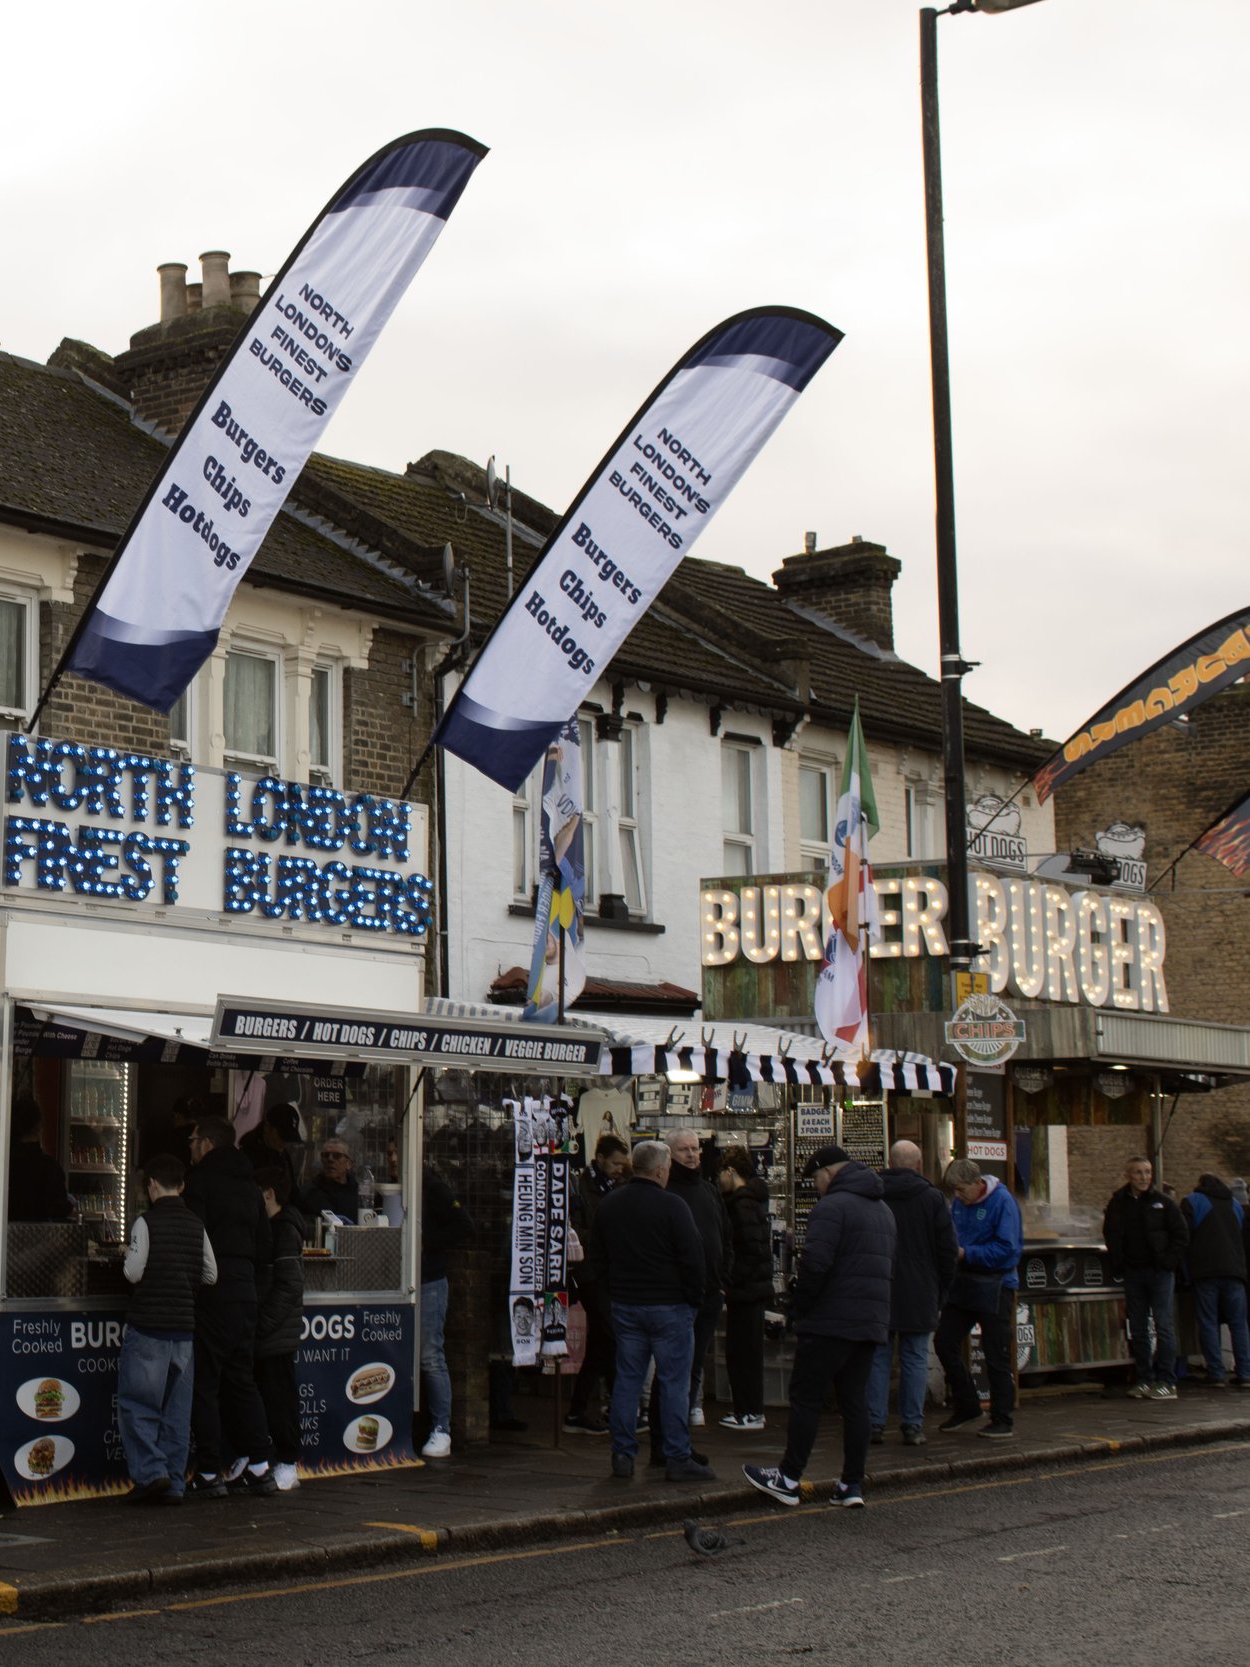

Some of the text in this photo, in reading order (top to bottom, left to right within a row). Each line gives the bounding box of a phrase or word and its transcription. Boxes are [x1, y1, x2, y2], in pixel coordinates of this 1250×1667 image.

[274, 294, 352, 372] LONDON'S
[298, 283, 354, 340] NORTH
[248, 338, 328, 416] BURGERS
[270, 325, 328, 384] FINEST
[210, 400, 287, 485] Burgers
[656, 427, 712, 486] NORTH
[202, 455, 251, 518] Chips
[629, 461, 688, 520] FINEST
[633, 434, 711, 515] LONDON'S
[161, 483, 241, 571] Hotdogs
[608, 470, 683, 550] BURGERS
[571, 522, 643, 605] Burgers
[558, 569, 607, 629] Chips
[524, 590, 595, 675] Hotdogs
[6, 733, 413, 863] NORTH LONDON
[5, 815, 433, 936] FINEST BURGERS
[991, 836, 1024, 863] DOGS
[700, 873, 1170, 1013] BURER BURGER
[234, 1015, 297, 1039] BURGERS
[313, 1021, 339, 1043] HOT
[340, 1024, 375, 1046] DOGS
[390, 1029, 426, 1050] CHIPS
[441, 1034, 491, 1055] CHICKEN
[504, 1038, 544, 1059] VEGGIE
[544, 1042, 586, 1063] BURGER
[955, 1023, 1016, 1039] CHIPS
[314, 1078, 343, 1089] ORDER
[318, 1092, 341, 1103] HERE
[801, 1108, 830, 1116] BADGES
[968, 1145, 1004, 1157] HOT DOGS
[535, 1160, 547, 1209] CONOR
[518, 1174, 534, 1285] HEUNG MIN SON
[548, 1225, 564, 1283] SARR
[12, 1338, 63, 1354] Cooked
[13, 1319, 61, 1336] Freshly
[71, 1321, 127, 1349] BUR
[361, 1328, 402, 1342] Cooked
[363, 1310, 401, 1326] Freshly
[303, 1348, 338, 1363] WANT
[341, 1347, 350, 1361] IT
